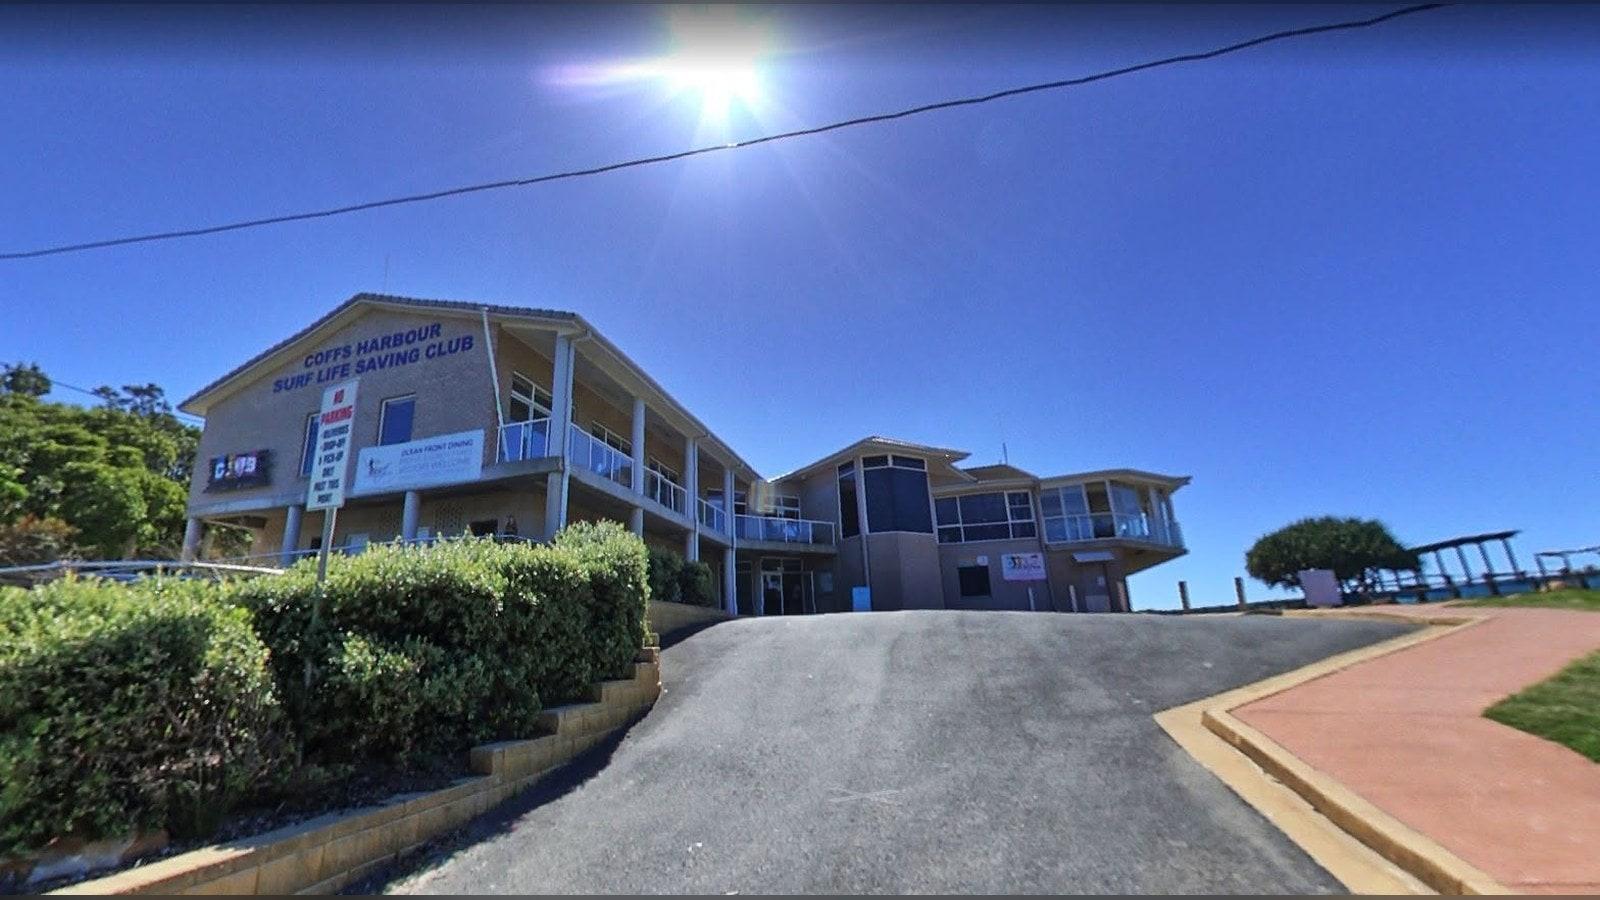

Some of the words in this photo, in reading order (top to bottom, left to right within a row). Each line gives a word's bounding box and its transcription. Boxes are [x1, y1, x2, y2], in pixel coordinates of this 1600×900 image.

[304, 345, 352, 369] COFFS
[356, 322, 442, 355] HARBOUR
[273, 373, 314, 393] SURF
[316, 362, 350, 384] LIFE
[355, 348, 420, 375] SAVING
[425, 335, 474, 360] CLUB
[333, 389, 345, 405] NO
[320, 405, 353, 426] PARKING
[424, 442, 447, 453] FRONT
[448, 438, 474, 450] DINING
